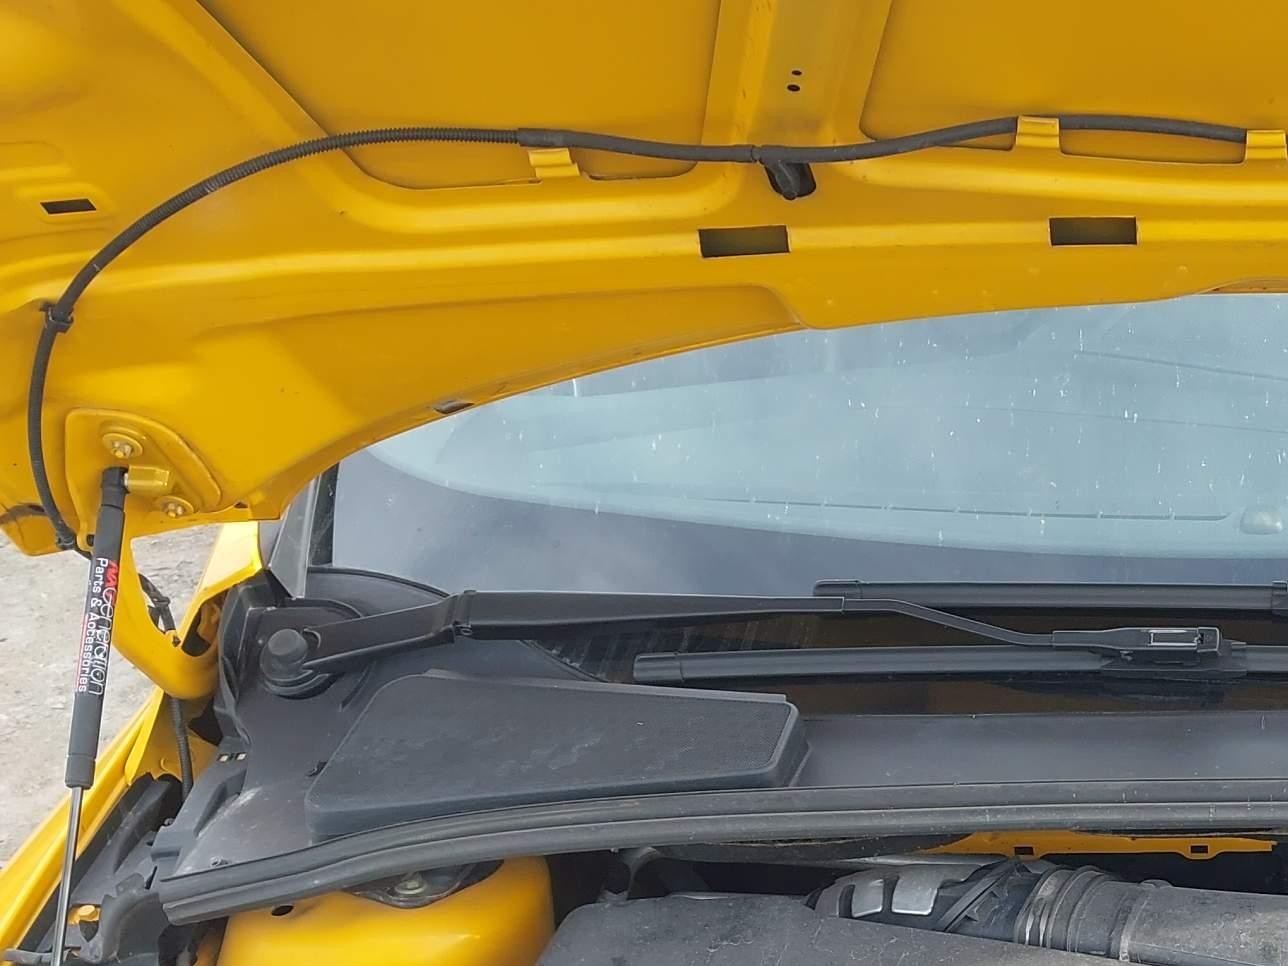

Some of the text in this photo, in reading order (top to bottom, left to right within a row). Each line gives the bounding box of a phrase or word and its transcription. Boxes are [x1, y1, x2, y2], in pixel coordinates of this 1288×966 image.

[78, 557, 109, 693] Parts & Accessories
